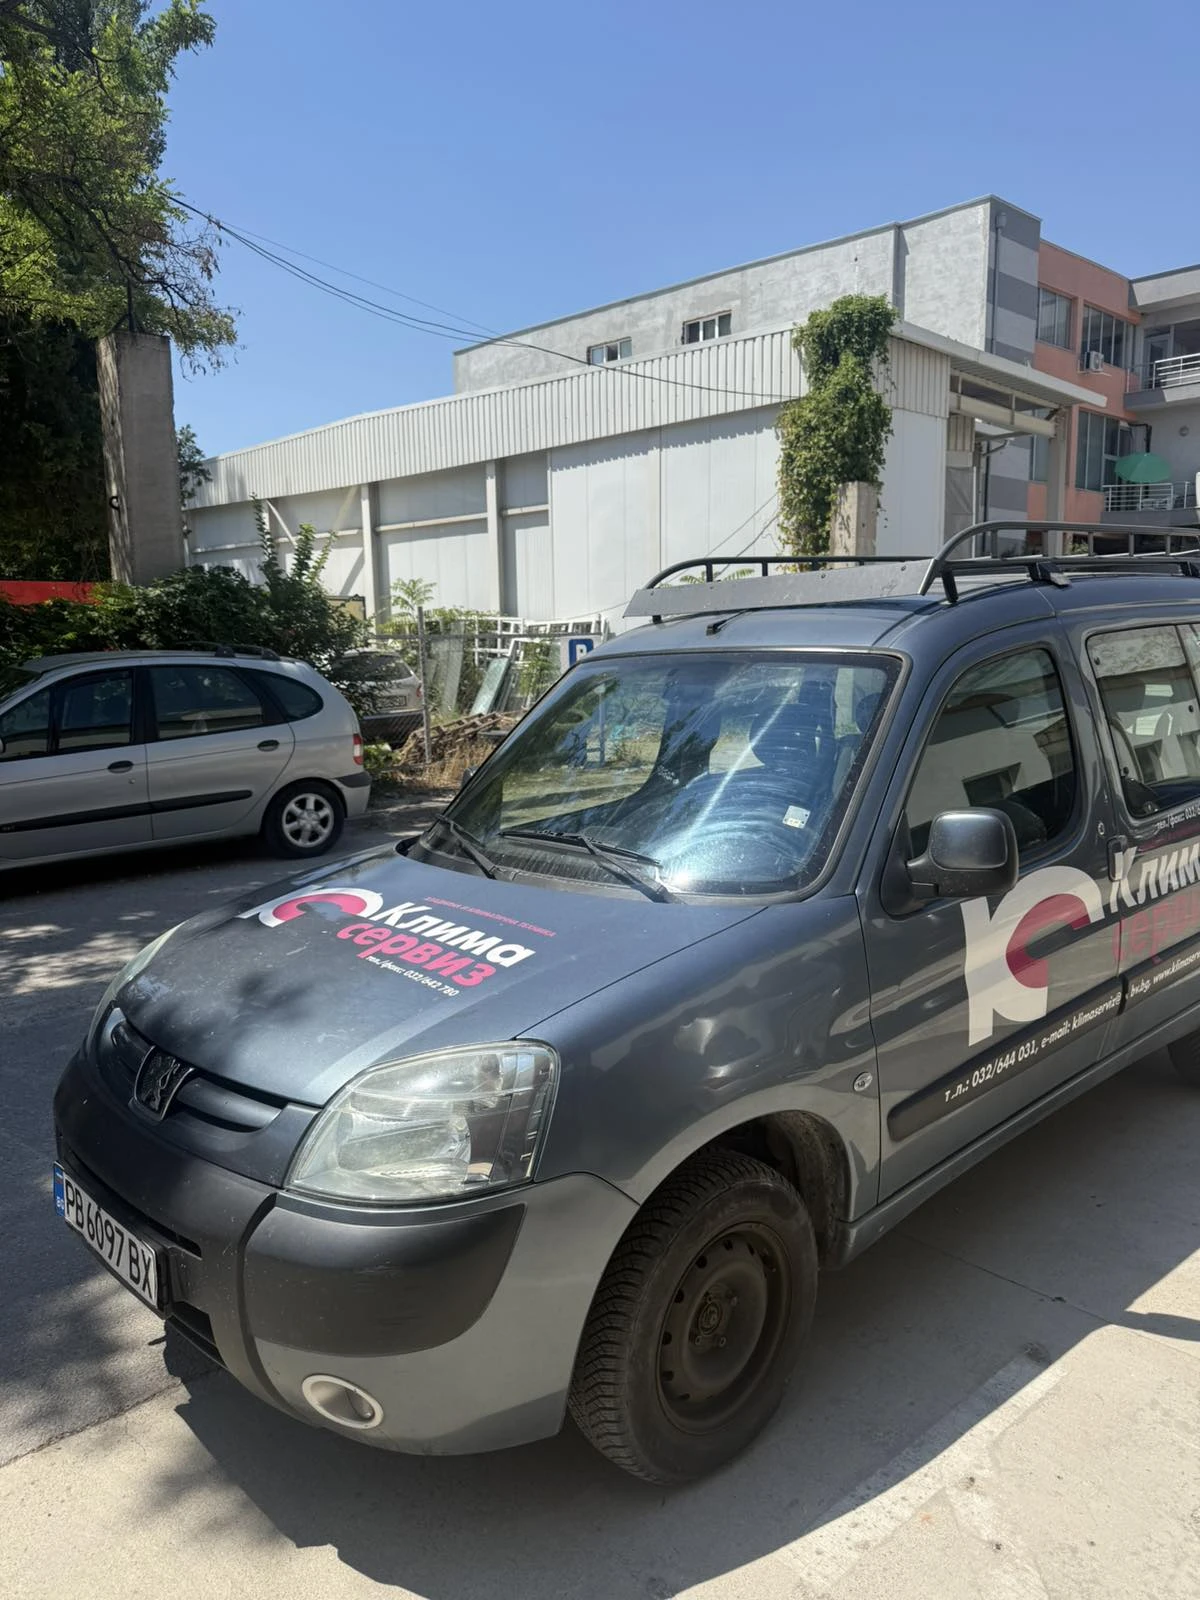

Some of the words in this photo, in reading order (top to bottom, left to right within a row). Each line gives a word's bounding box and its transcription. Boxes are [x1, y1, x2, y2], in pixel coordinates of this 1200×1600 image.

[336, 923, 497, 987] сервиз
[369, 902, 536, 968] Клима
[972, 1050, 1016, 1088] 032/644
[1018, 1039, 1040, 1062] 031,
[1041, 1020, 1071, 1048] e-mail:
[65, 1179, 84, 1230] PB
[87, 1202, 124, 1268] 6097
[128, 1239, 153, 1300] BX
